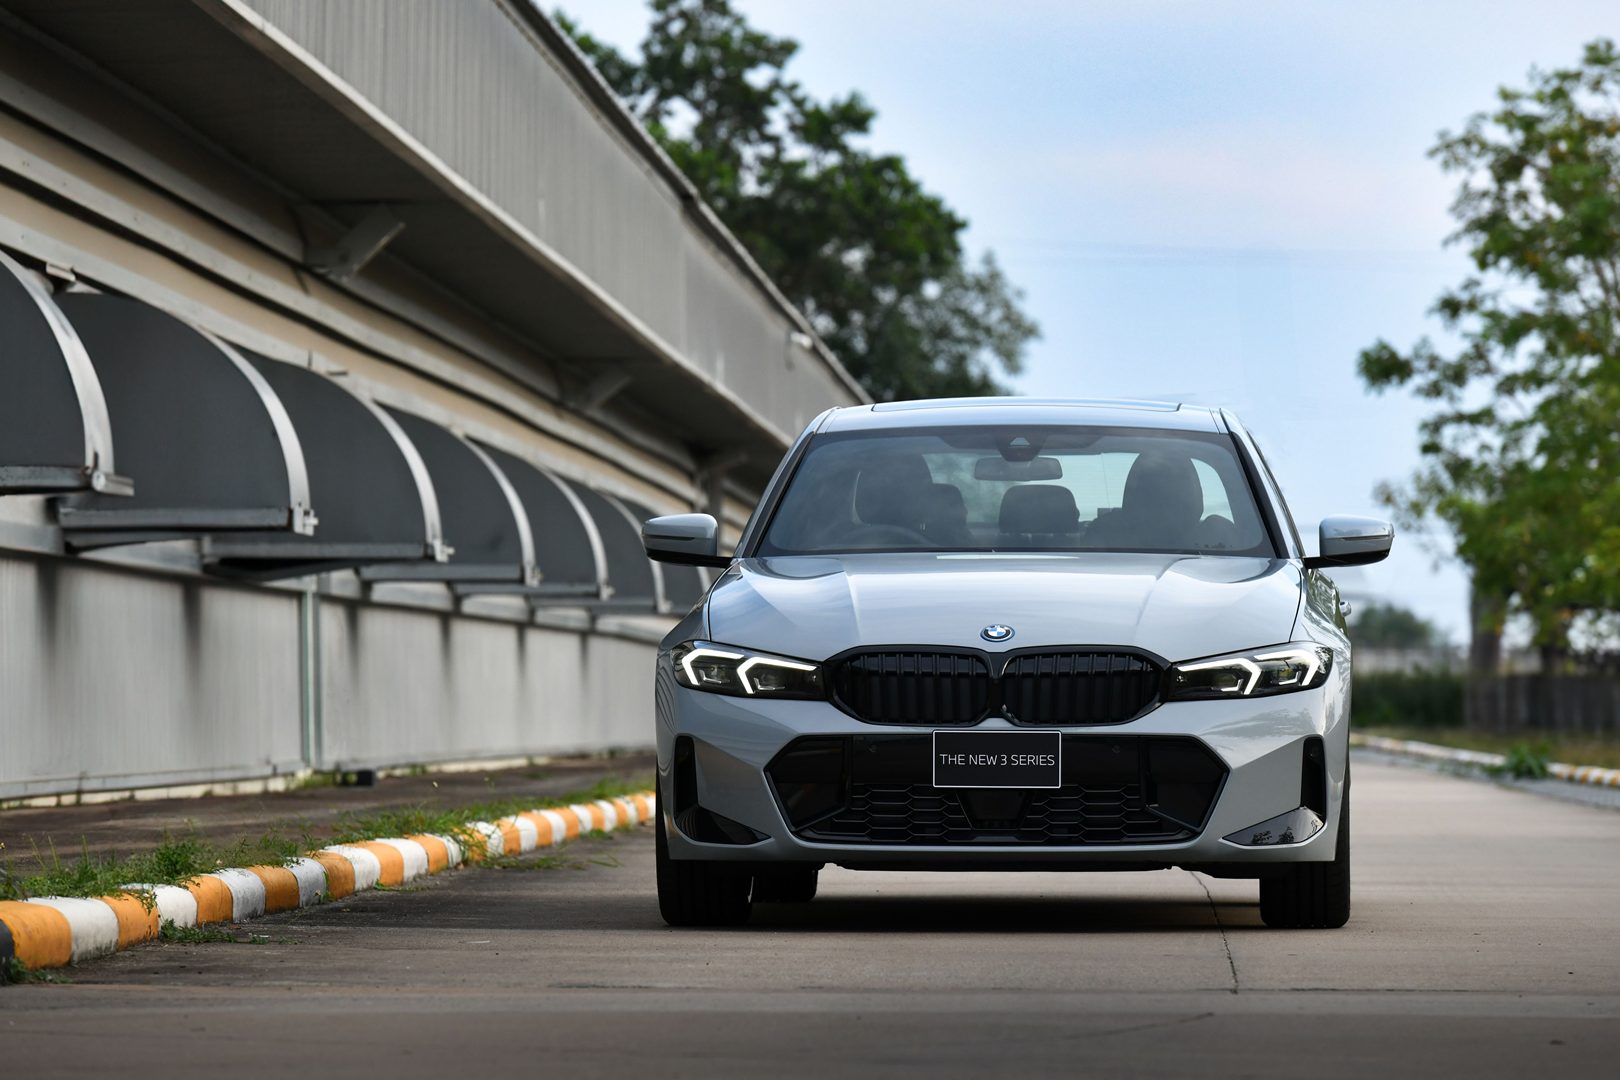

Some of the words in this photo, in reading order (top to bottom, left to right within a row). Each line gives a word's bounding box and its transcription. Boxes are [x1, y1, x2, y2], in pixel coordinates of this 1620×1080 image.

[939, 754, 966, 765] THE
[969, 754, 998, 766] NEW
[1000, 754, 1008, 766] 3
[1010, 754, 1055, 766] SERIES
